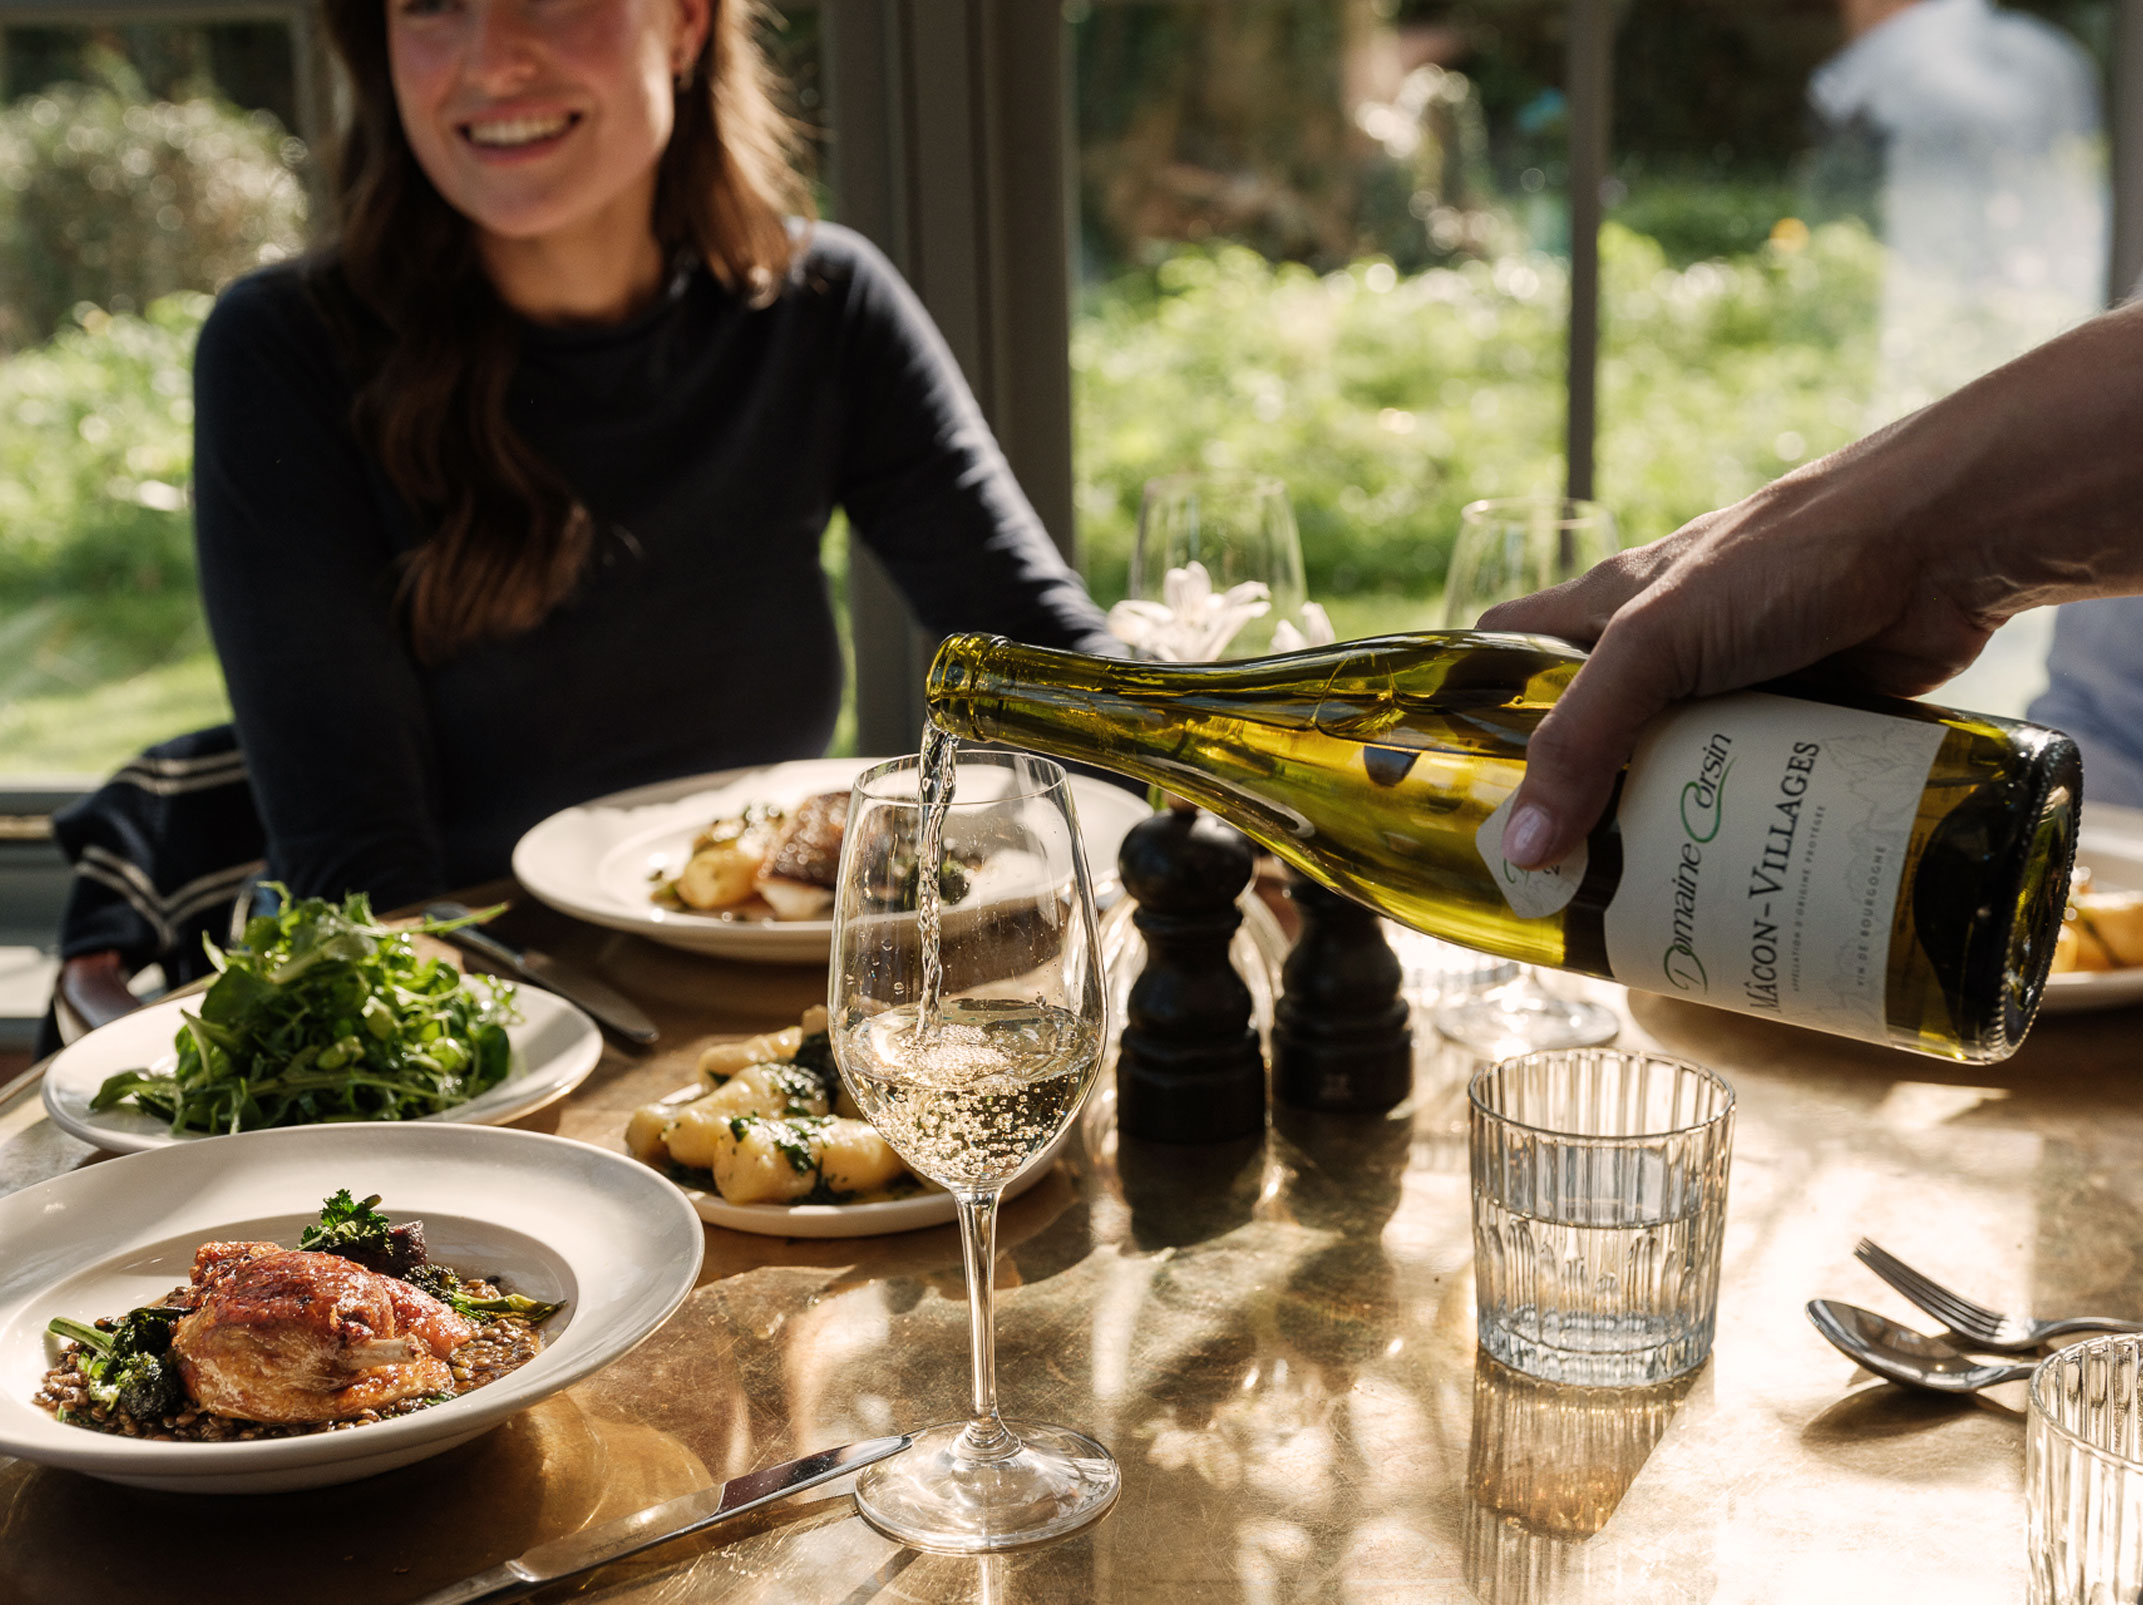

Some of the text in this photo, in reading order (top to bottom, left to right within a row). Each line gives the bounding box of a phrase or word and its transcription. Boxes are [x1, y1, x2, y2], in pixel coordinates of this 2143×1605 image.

[1664, 733, 1738, 994] Domaine Corsin
[1860, 846, 1887, 937] BOURGOGNE
[1791, 931, 1801, 993] APPELLATION
[1857, 945, 1869, 961] DE
